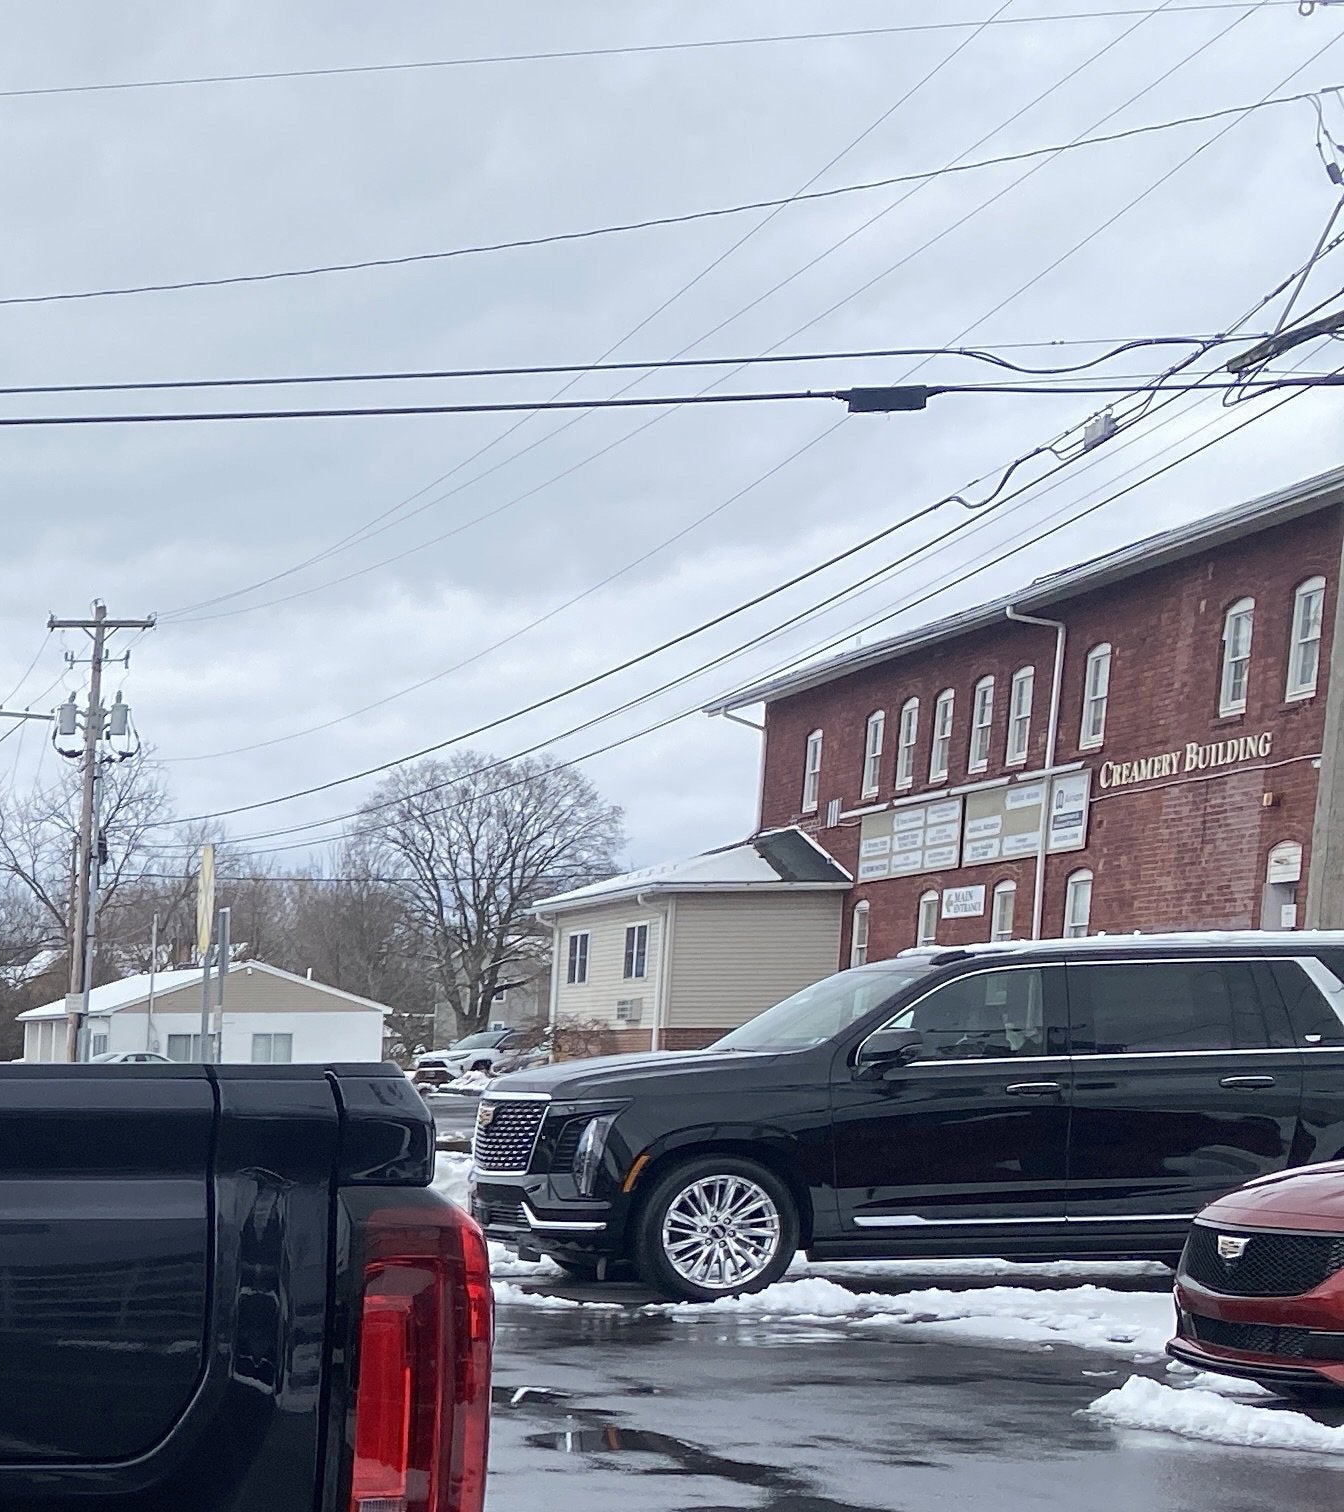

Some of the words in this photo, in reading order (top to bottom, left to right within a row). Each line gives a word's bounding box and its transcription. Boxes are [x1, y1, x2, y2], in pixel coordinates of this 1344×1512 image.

[1099, 751, 1182, 788] CREAMERY
[1184, 732, 1273, 772] BUILDING
[954, 890, 973, 902] MAIN
